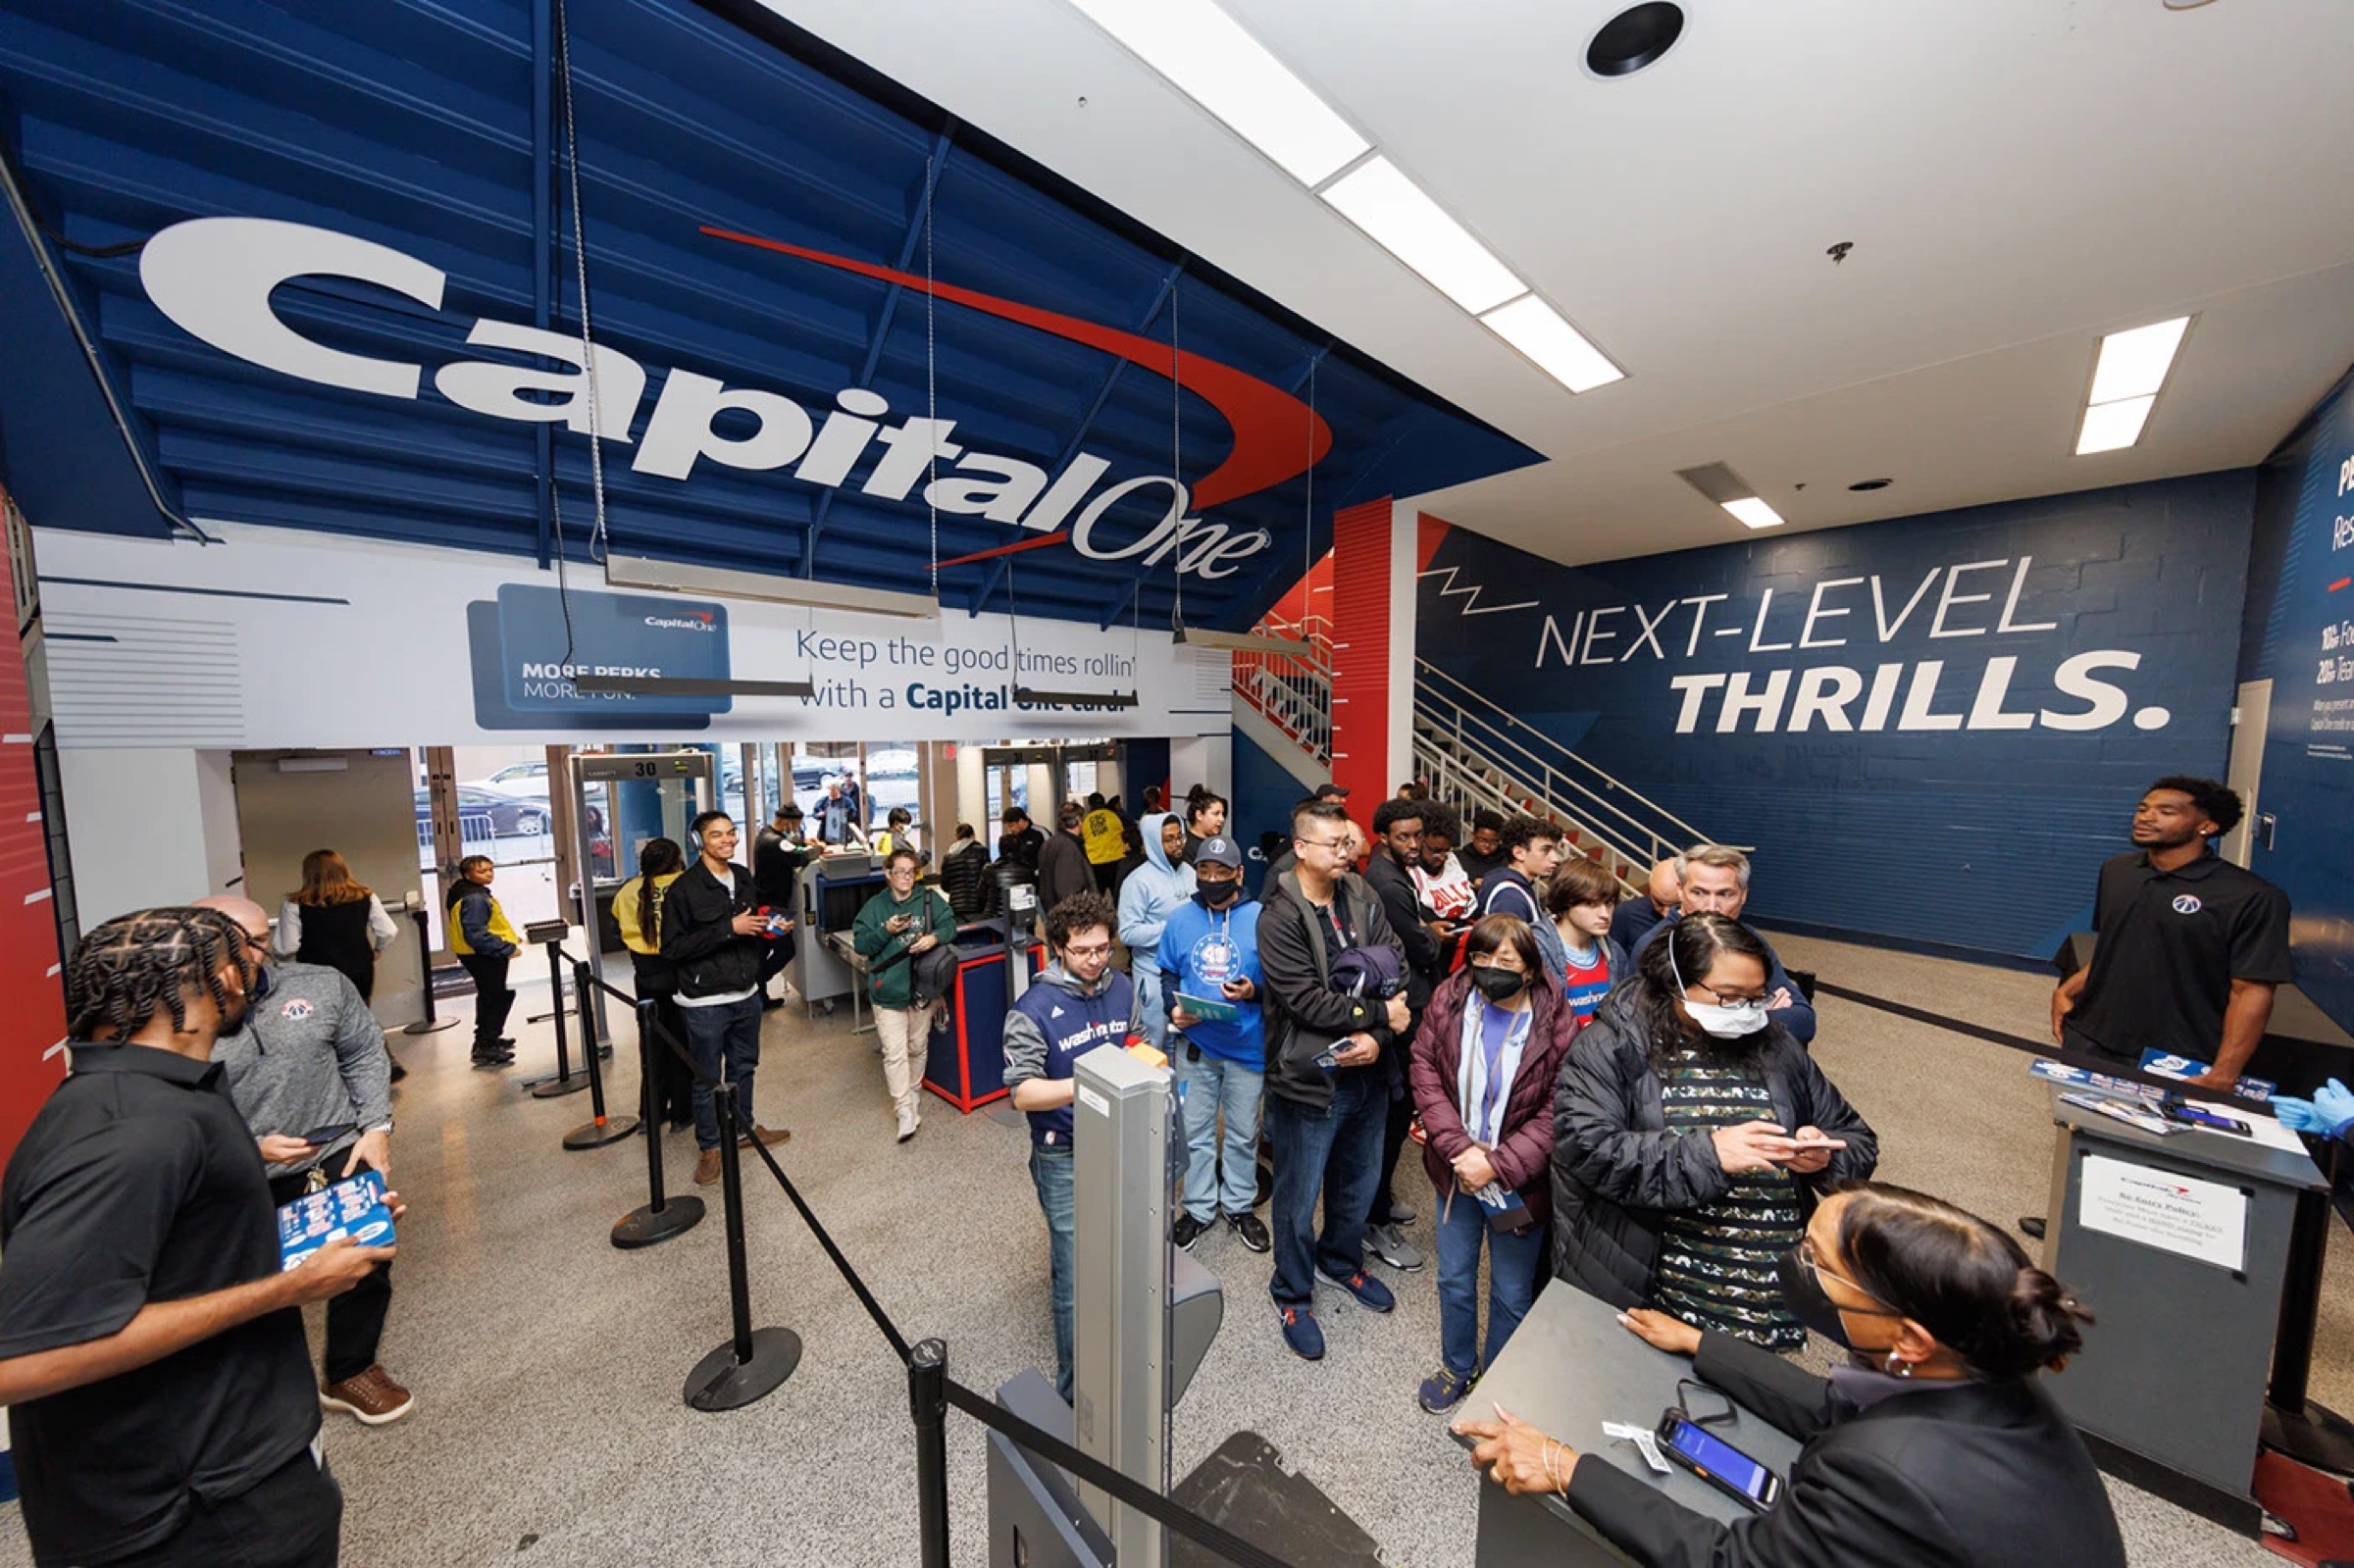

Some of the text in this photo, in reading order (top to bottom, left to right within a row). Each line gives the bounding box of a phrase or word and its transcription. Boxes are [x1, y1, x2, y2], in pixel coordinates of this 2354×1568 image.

[1535, 556, 2059, 668] NEXT-LEVEL
[796, 630, 877, 669] Keep
[888, 636, 935, 667] the
[945, 645, 1008, 675] good
[1015, 648, 1077, 675] times
[879, 687, 896, 708] a
[906, 683, 1007, 716] Capital
[1669, 650, 2171, 733] THRILLS.
[635, 761, 656, 778] 30
